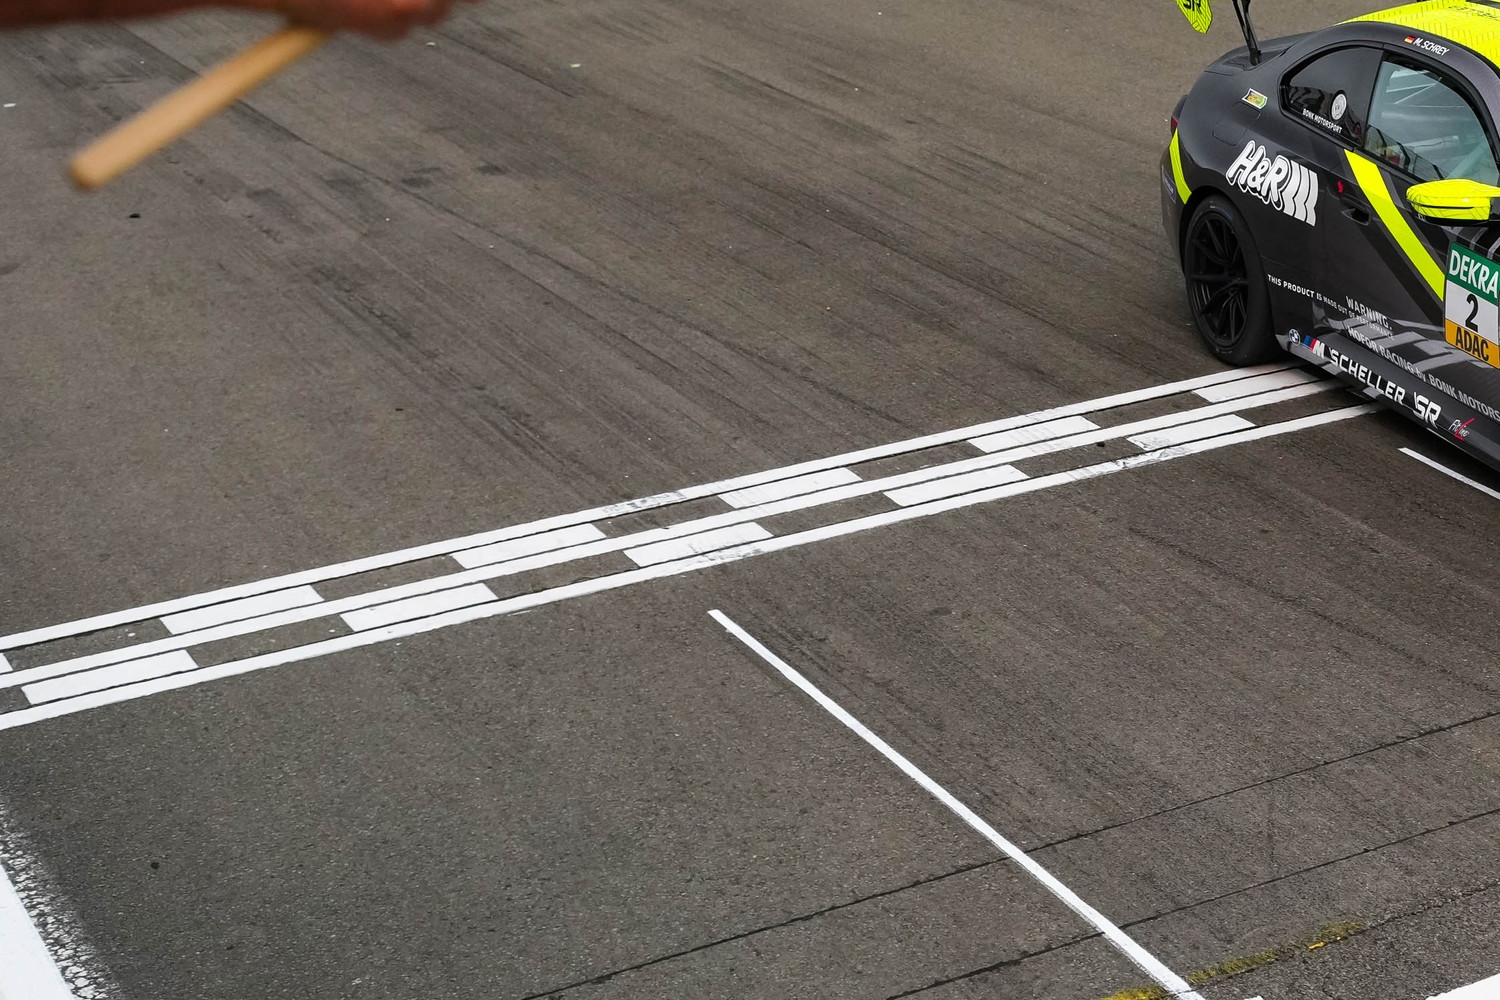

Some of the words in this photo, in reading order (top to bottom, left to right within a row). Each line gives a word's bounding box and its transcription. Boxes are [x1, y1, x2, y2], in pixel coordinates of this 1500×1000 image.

[1413, 37, 1423, 47] M.
[1421, 41, 1450, 56] SCHREY
[1314, 114, 1342, 133] MOTORSPORT
[1226, 140, 1292, 210] H&R
[1267, 274, 1282, 287] THIS
[1283, 281, 1315, 298] PRODUCT
[1316, 292, 1323, 302] IS
[1449, 249, 1499, 299] DEKRA
[1345, 296, 1393, 330] WARNING.
[1465, 293, 1478, 333] 2
[1348, 326, 1379, 355] HOFOR
[1380, 345, 1415, 375] RACING
[1429, 373, 1458, 400] BONK
[1455, 326, 1489, 362] ADAC
[1329, 347, 1405, 406] SCHELLER
[1412, 392, 1442, 430] SR
